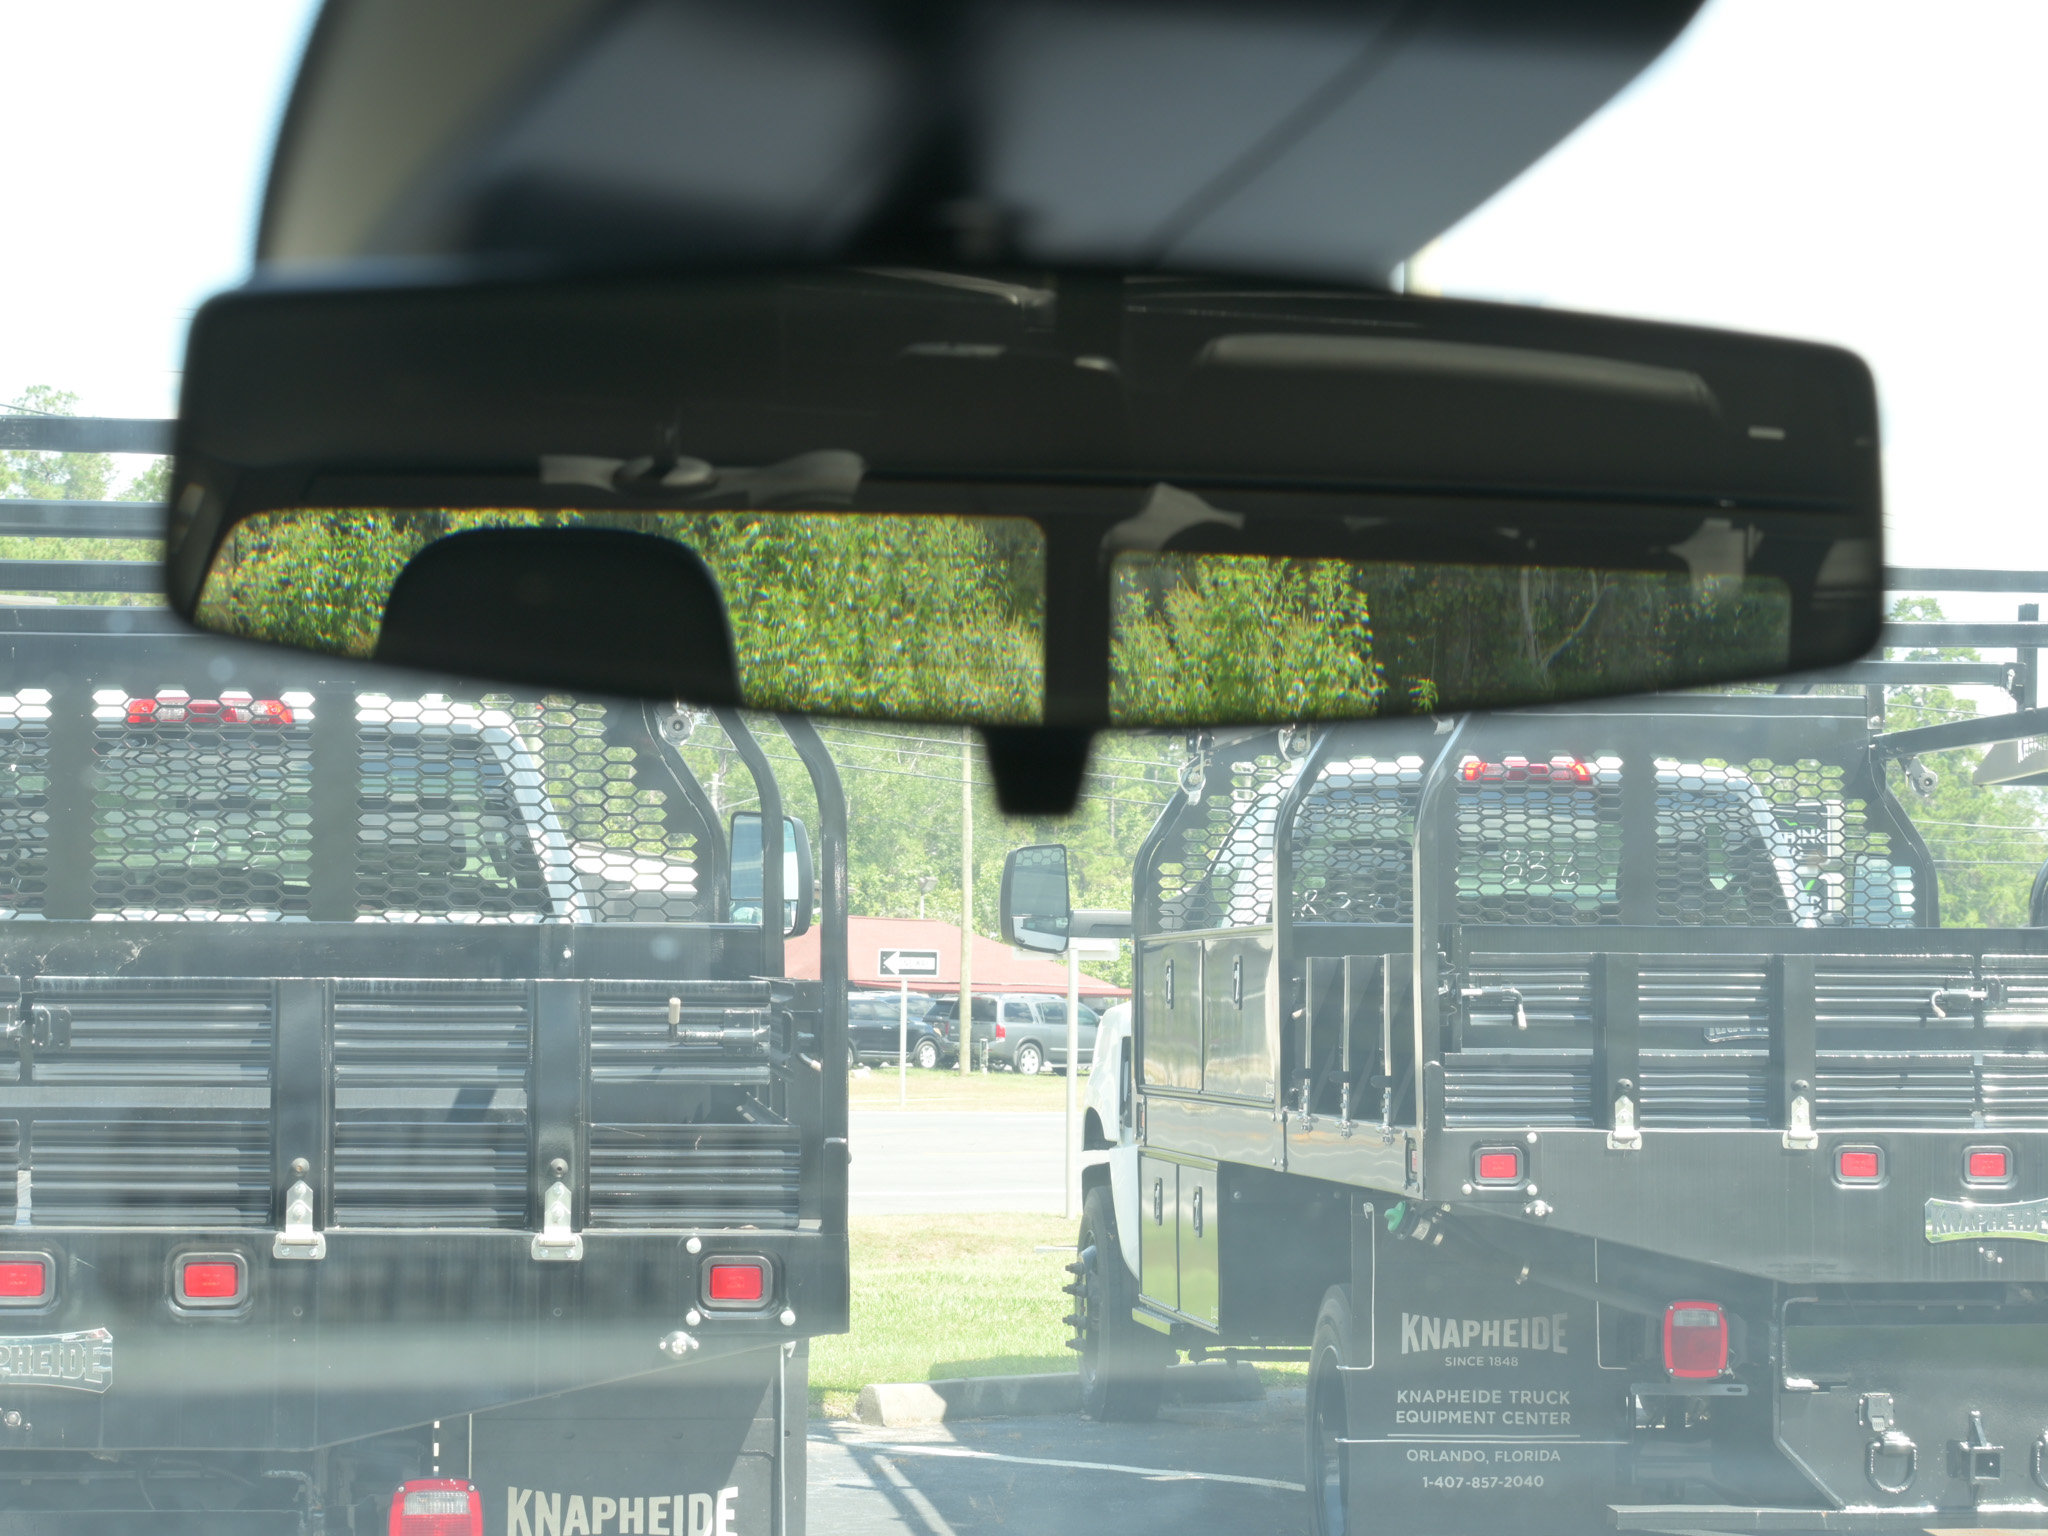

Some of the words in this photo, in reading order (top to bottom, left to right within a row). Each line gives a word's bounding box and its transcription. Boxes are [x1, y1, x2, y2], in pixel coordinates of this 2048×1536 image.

[1401, 1312, 1569, 1355] KNAPHEIDE
[1445, 1356, 1484, 1367] SINCE
[1488, 1356, 1519, 1367] 1848
[1397, 1390, 1502, 1404] KNAPHEIDE
[1509, 1390, 1570, 1405] TRUCK
[1396, 1411, 1495, 1424] EQUIPMENT
[1502, 1411, 1571, 1425] CENTER
[1406, 1449, 1490, 1465] ORLANDO,
[1495, 1450, 1561, 1462] FLORIDA
[1423, 1475, 1544, 1489] 1-407-857-2040
[507, 1486, 739, 1536] KNAPHEIDE
